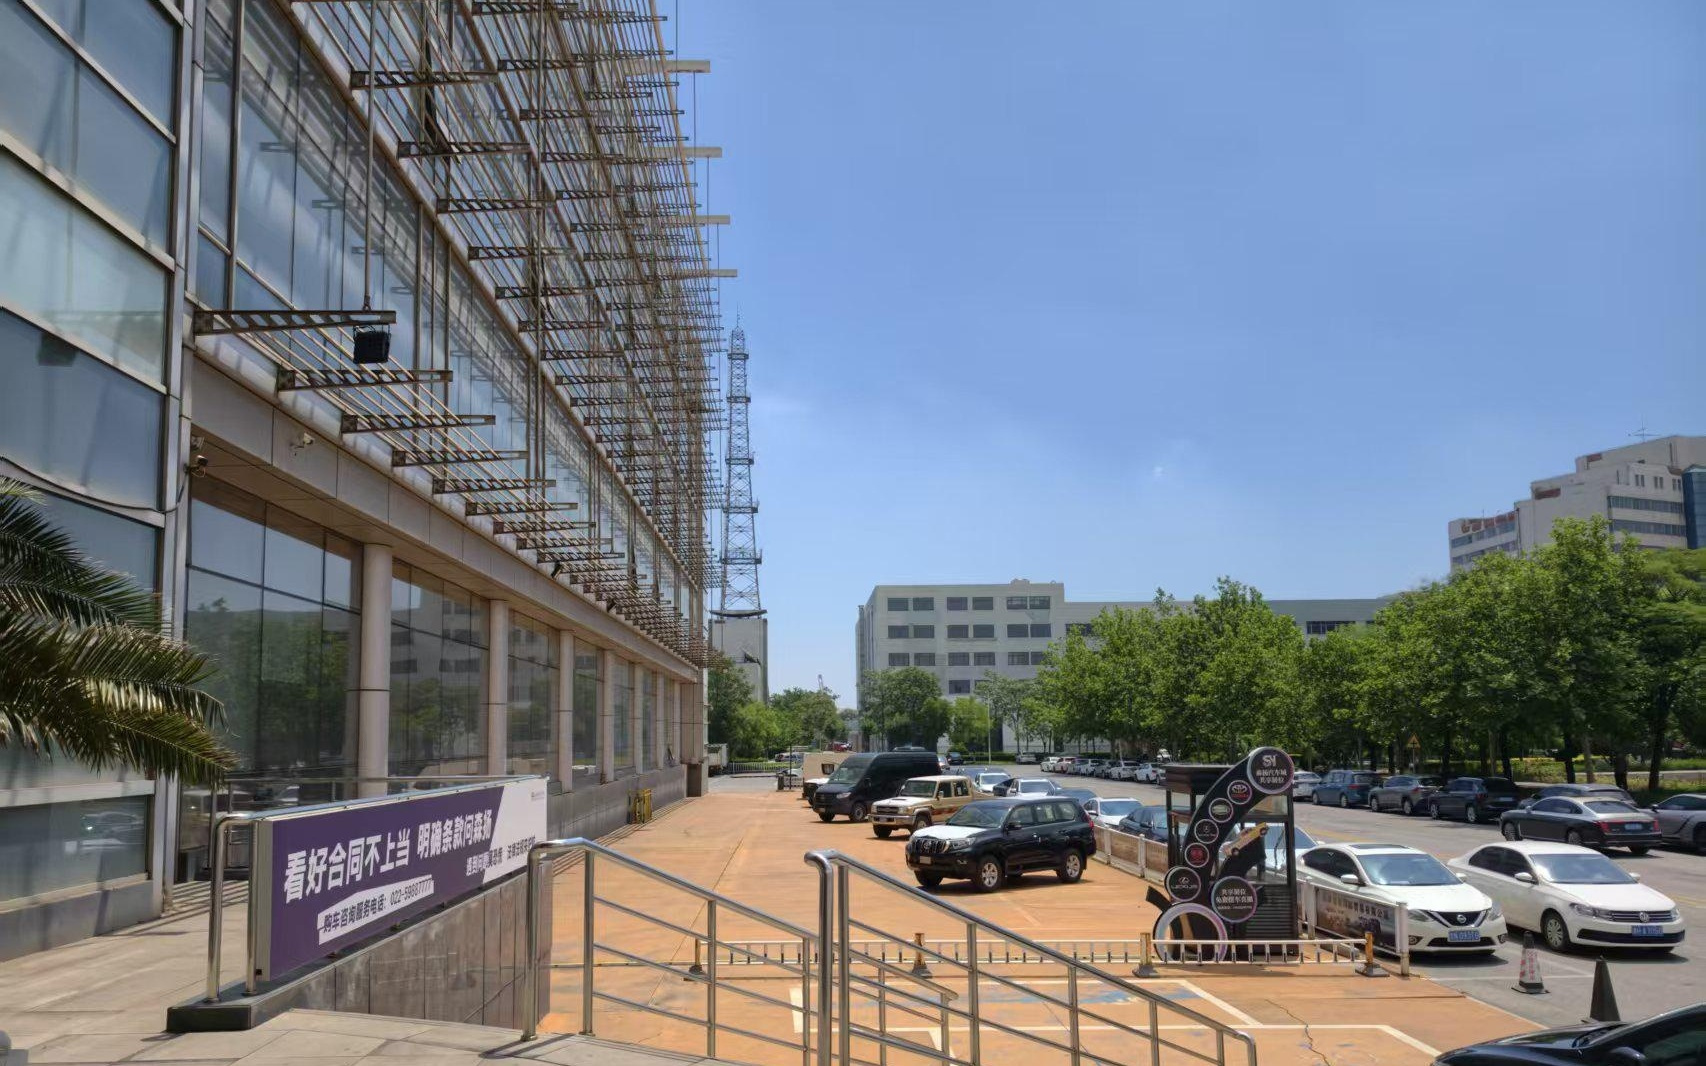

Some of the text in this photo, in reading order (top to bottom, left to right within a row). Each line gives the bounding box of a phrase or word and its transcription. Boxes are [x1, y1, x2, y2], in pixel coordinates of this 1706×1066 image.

[284, 809, 493, 904] 看好合同不上当 明确条款问森扬
